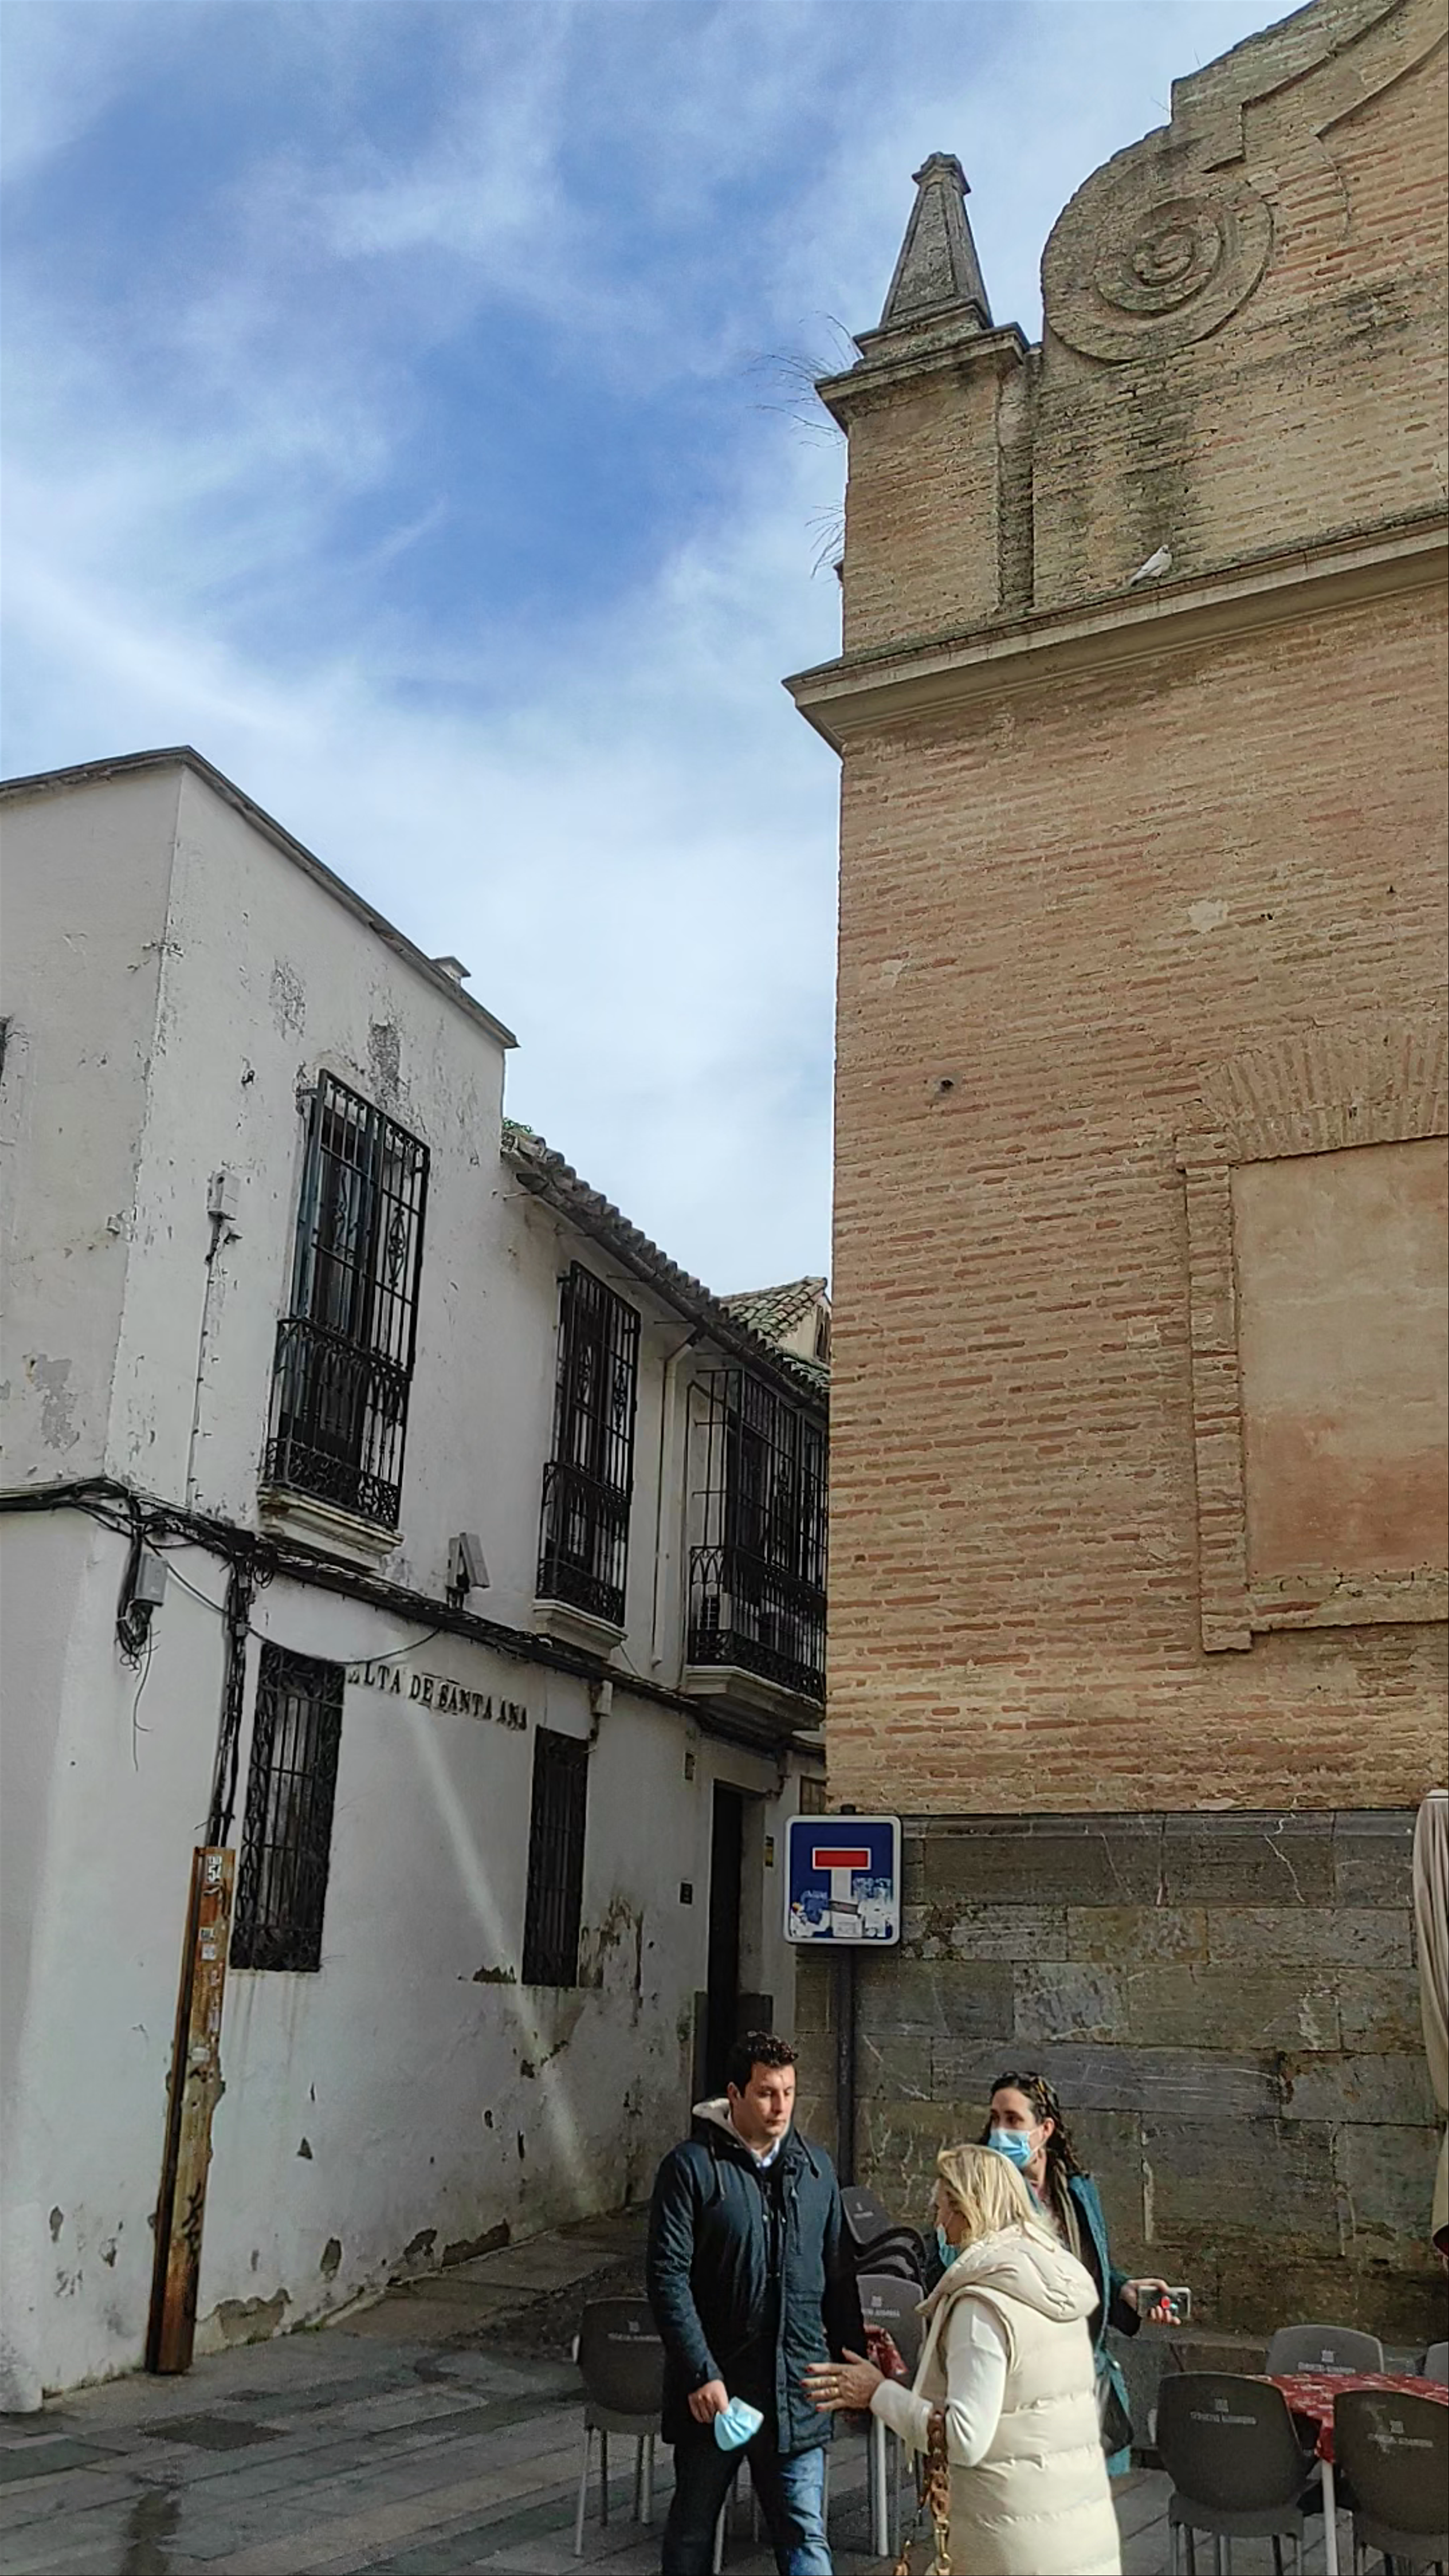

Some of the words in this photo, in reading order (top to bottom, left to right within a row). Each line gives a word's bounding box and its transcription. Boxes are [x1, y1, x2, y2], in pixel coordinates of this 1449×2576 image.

[409, 1675, 434, 1702] DE
[439, 1684, 492, 1720] SANTA
[496, 1700, 527, 1730] ANA
